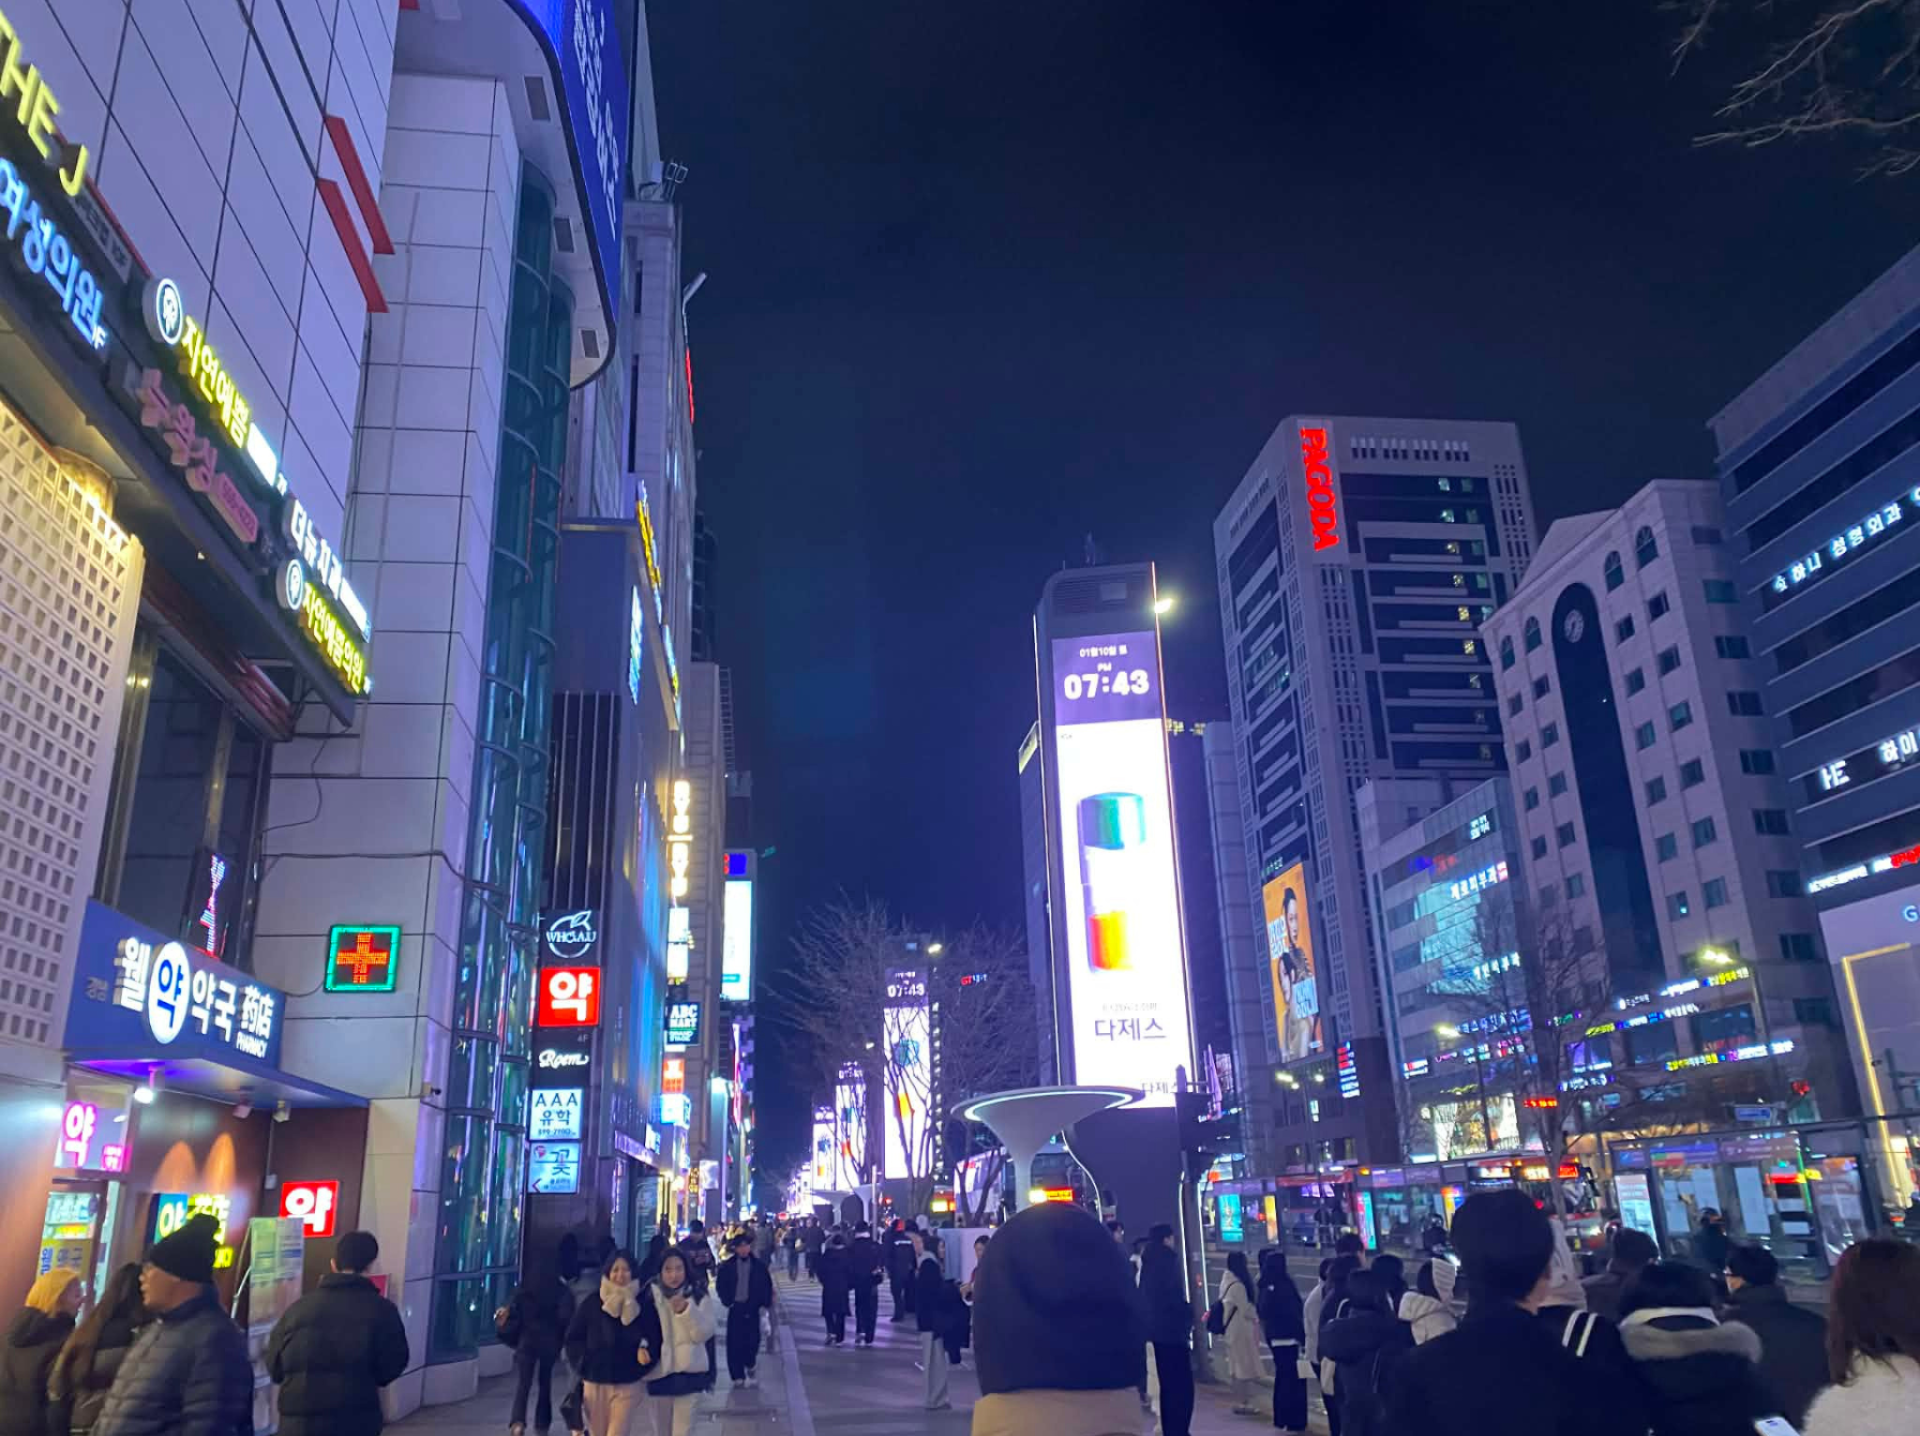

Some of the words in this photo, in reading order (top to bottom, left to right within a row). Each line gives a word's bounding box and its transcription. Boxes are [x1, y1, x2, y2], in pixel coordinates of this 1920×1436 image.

[1299, 427, 1341, 552] PAGODA
[1830, 502, 1902, 558] 성형외과
[1063, 669, 1150, 701] 07:43
[192, 969, 237, 1043] 약국
[548, 970, 594, 1022] 약
[670, 1003, 698, 1019] ABC
[1094, 1016, 1167, 1042] 다제스
[64, 1104, 96, 1168] 약
[540, 1109, 571, 1126] 유학
[284, 1187, 333, 1233] 약
